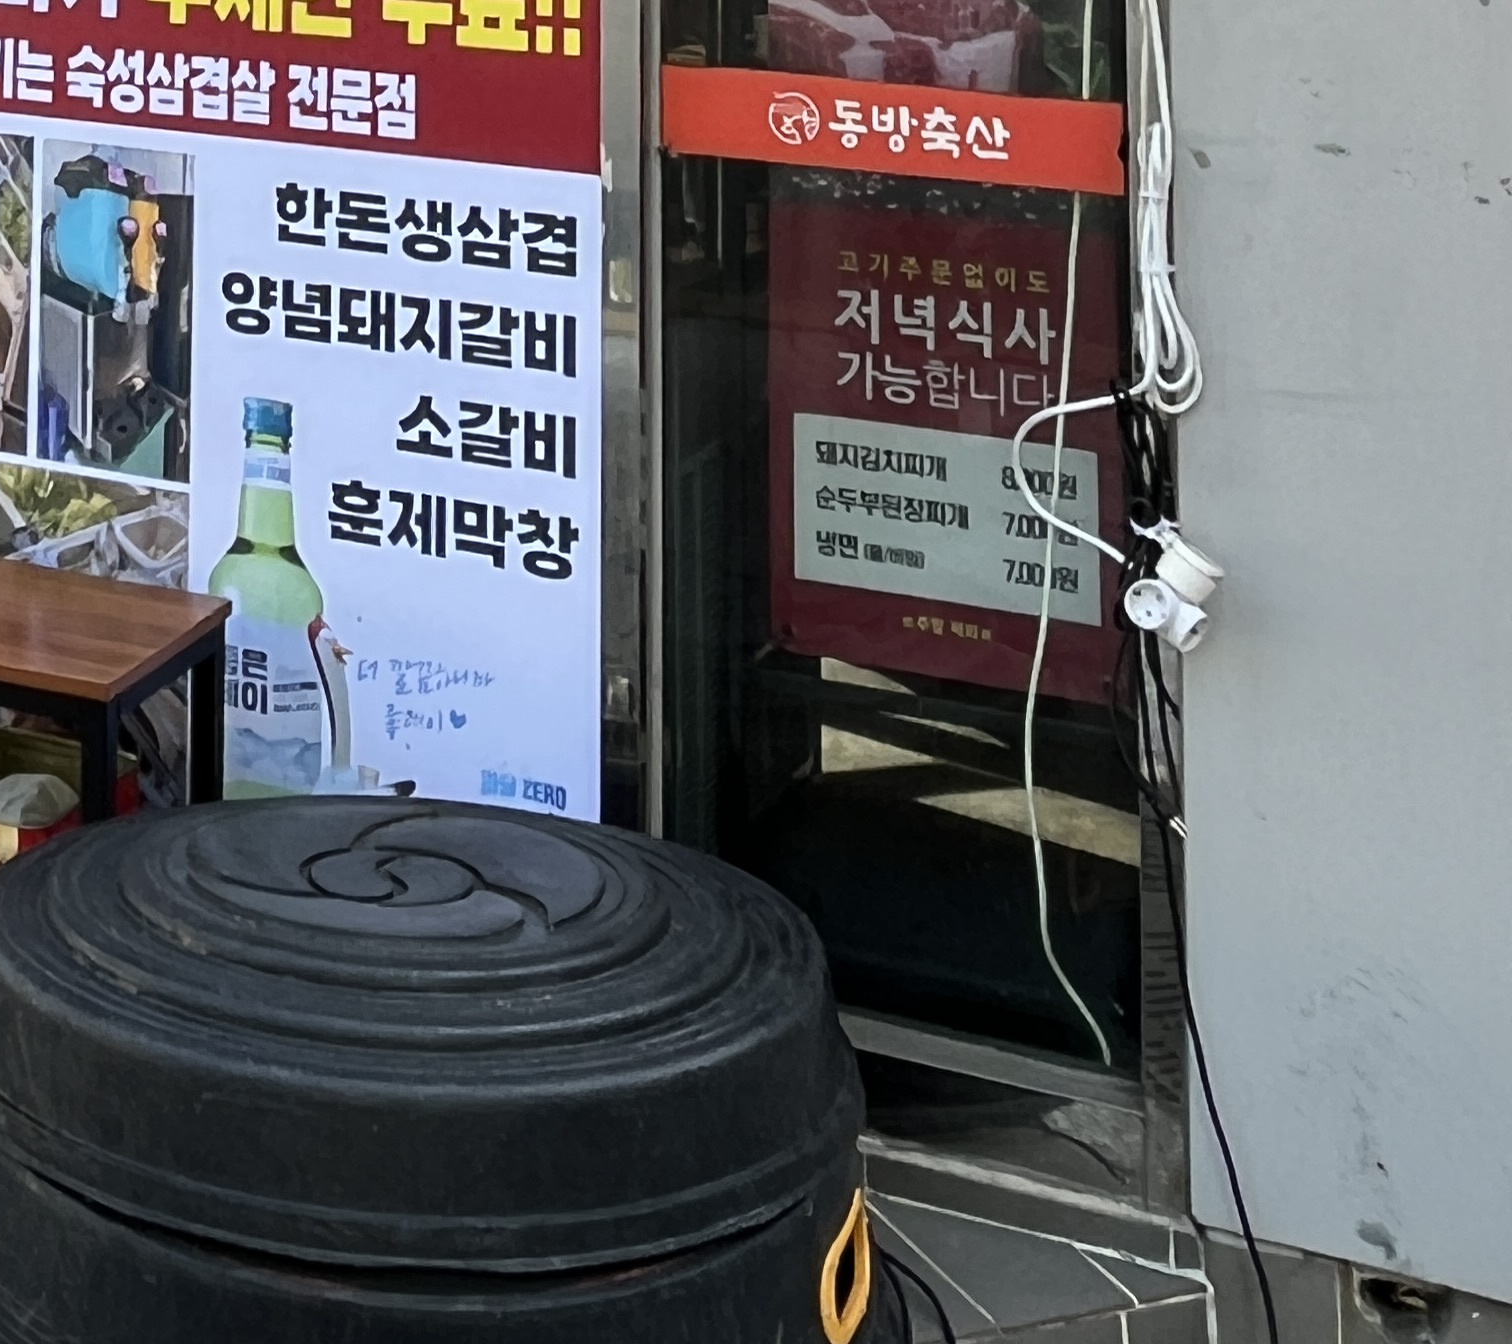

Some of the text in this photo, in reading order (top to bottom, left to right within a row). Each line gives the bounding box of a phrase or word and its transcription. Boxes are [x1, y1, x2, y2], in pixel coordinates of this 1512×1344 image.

[65, 44, 276, 127] 숙성삼겹살
[286, 63, 417, 140] 전문점
[828, 97, 1011, 161] 동방축산
[275, 181, 578, 278] 한돈생삼겹
[221, 271, 577, 379] 양념돼지갈비
[833, 288, 1057, 366] 저녁식사
[836, 350, 1056, 417] 가능합니다
[395, 394, 577, 480] 소갈비
[327, 479, 580, 581] 훈제막창
[815, 529, 859, 561] 냉면
[522, 777, 567, 812] ZERO
